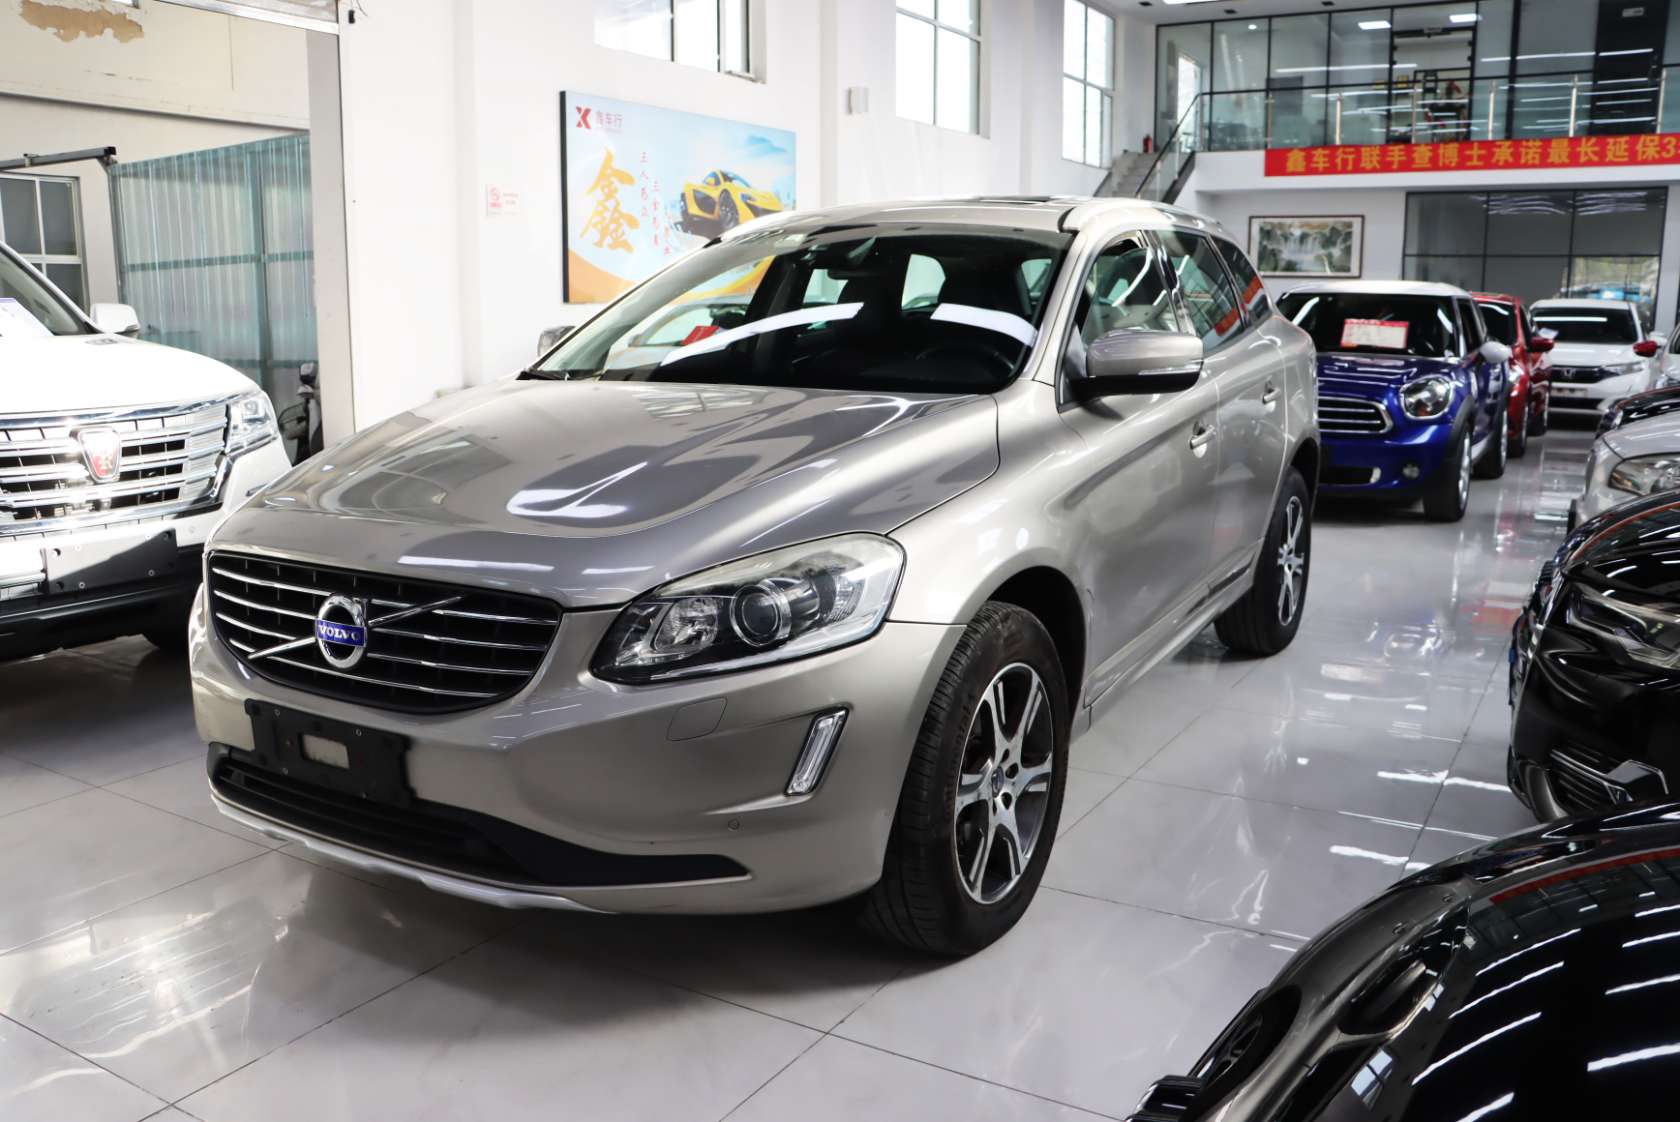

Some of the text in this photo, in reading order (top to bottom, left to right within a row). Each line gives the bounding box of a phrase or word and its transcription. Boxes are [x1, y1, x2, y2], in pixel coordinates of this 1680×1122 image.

[1286, 134, 1680, 173] 鑫车行联手查博士承诺最长延保3
